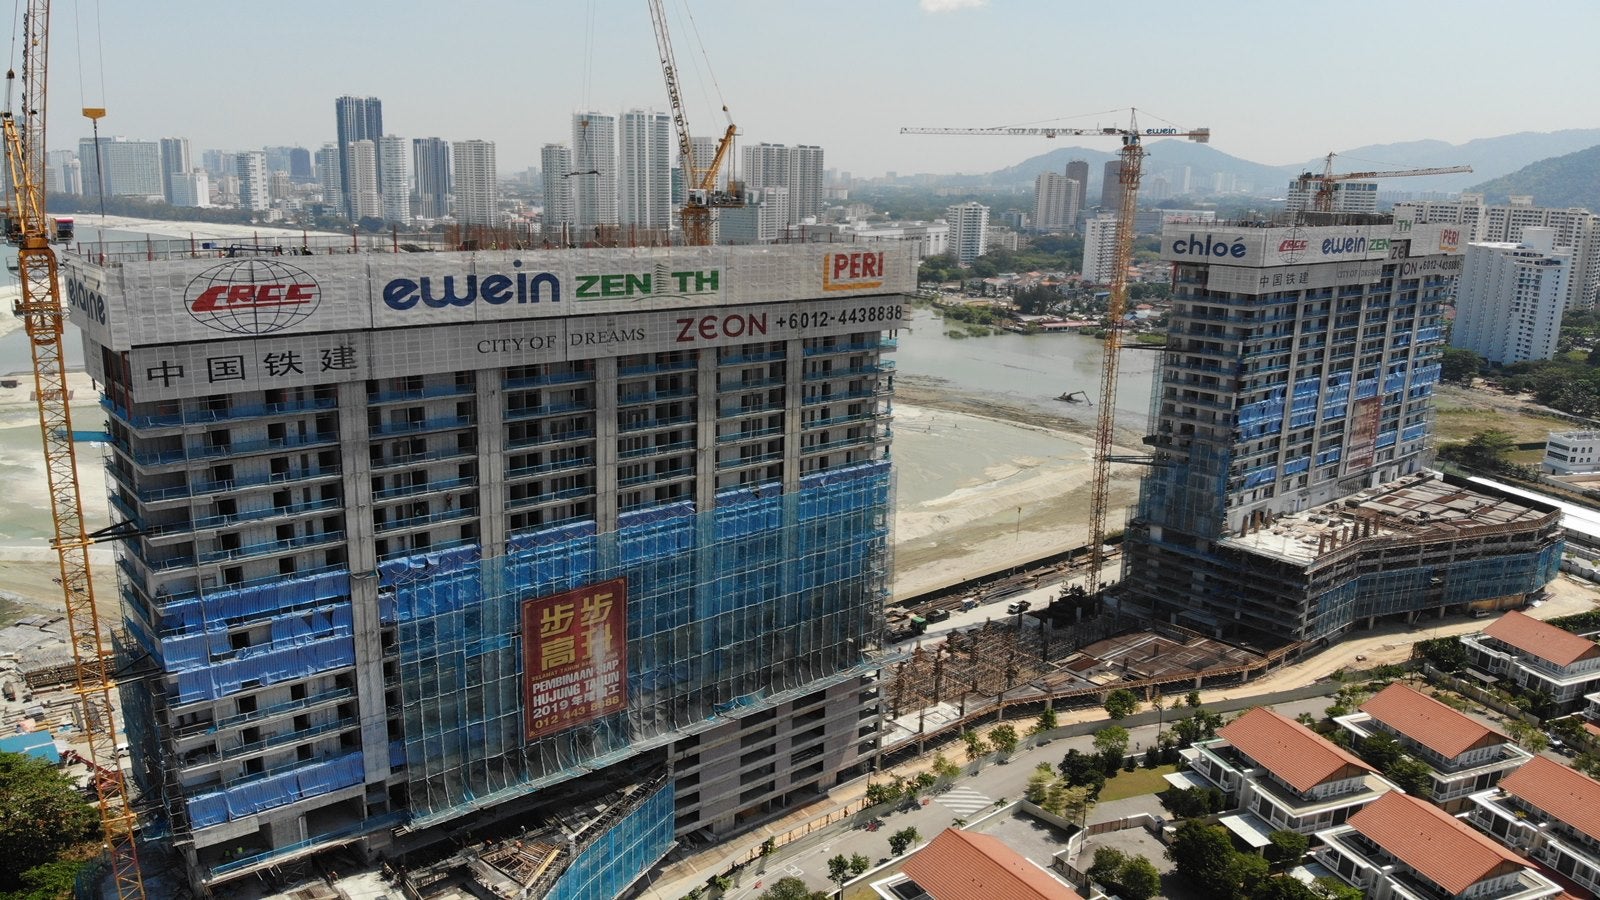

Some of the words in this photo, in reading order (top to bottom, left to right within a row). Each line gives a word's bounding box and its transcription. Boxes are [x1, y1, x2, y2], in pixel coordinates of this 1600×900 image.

[1146, 126, 1177, 135] ewein
[1173, 233, 1247, 258] chloé
[1322, 229, 1366, 255] ewein
[1442, 229, 1460, 246] PERI
[833, 252, 884, 280] PERI
[382, 260, 561, 311] ewein
[1260, 271, 1309, 288] 中国铁建
[676, 313, 767, 342] ZEON
[776, 305, 902, 330] +6012-4438888
[477, 337, 524, 354] CITY
[529, 336, 556, 350] OF
[570, 328, 645, 346] DREAMS
[147, 345, 358, 388] 中国铁建
[540, 592, 614, 638] 步步
[532, 667, 594, 694] PEMBINAAN
[533, 683, 581, 708] HUJUNG
[584, 671, 620, 692] TAHUN
[533, 700, 569, 719] 2019
[535, 715, 559, 728] 012
[562, 706, 586, 719] 443
[590, 696, 620, 711] 8888
